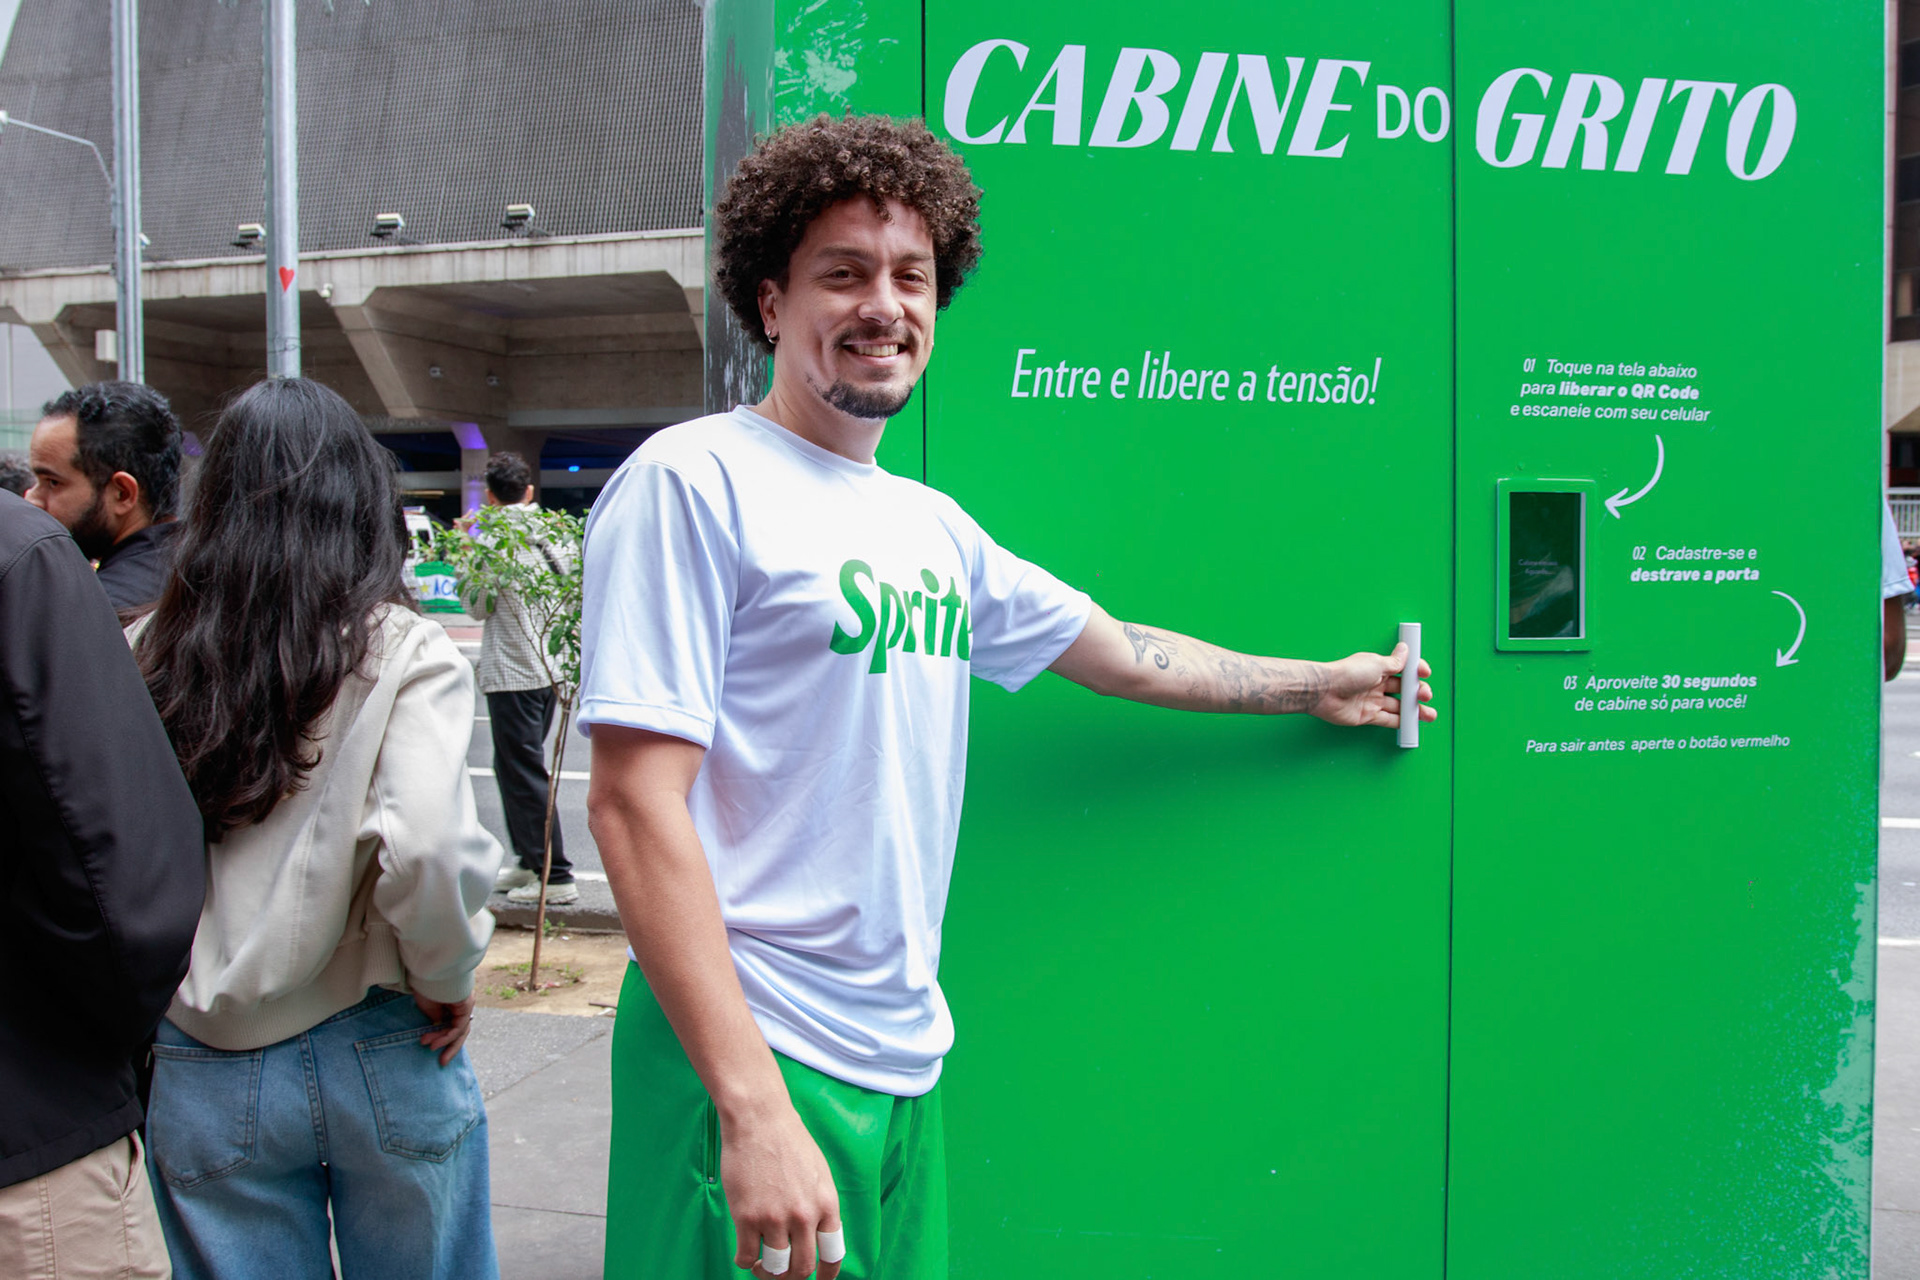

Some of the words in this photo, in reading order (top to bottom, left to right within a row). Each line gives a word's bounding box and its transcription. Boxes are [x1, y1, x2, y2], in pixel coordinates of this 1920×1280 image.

[944, 39, 1371, 158] CABINE
[1377, 85, 1450, 142] DO
[1476, 68, 1797, 180] GRITO
[1011, 349, 1098, 399] Entre
[1111, 368, 1129, 399] e
[1138, 351, 1229, 401] libere
[1238, 371, 1256, 401] a
[1267, 358, 1381, 404] tensão!
[1523, 358, 1536, 373] 01
[1548, 359, 1593, 377] Toque
[1596, 364, 1614, 375] na
[1618, 362, 1645, 377] tela
[1649, 364, 1698, 378] abaixo
[1520, 383, 1555, 397] para
[1559, 381, 1615, 397] liberar
[1618, 386, 1628, 397] o
[1631, 384, 1655, 399] QR
[1658, 384, 1699, 400] Code
[1510, 405, 1520, 416] e
[1522, 403, 1591, 418] escaneie
[1595, 407, 1627, 418] com
[1631, 408, 1658, 420] seu
[1661, 407, 1711, 421] celular
[1632, 546, 1647, 560] 02
[1656, 546, 1745, 560] Cadastre-se
[1748, 549, 1757, 560] e
[1631, 567, 1700, 582] destrave
[1703, 570, 1713, 581] a
[1715, 568, 1760, 584] porta
[1563, 676, 1578, 690] 03
[1585, 675, 1658, 692] Aproveite
[1661, 675, 1681, 688] 30
[1683, 674, 1757, 691] segundos
[1575, 697, 1594, 711] de
[1597, 697, 1647, 711] cabine
[1650, 694, 1669, 710] só
[1670, 698, 1704, 713] para
[1708, 694, 1747, 709] você!
[1526, 740, 1557, 753] Para
[1559, 740, 1586, 753] sair
[1588, 739, 1626, 752] antes
[1630, 737, 1675, 753] aperte
[1678, 740, 1687, 749] o
[1689, 735, 1728, 749] botão
[1731, 735, 1791, 748] vermelho
